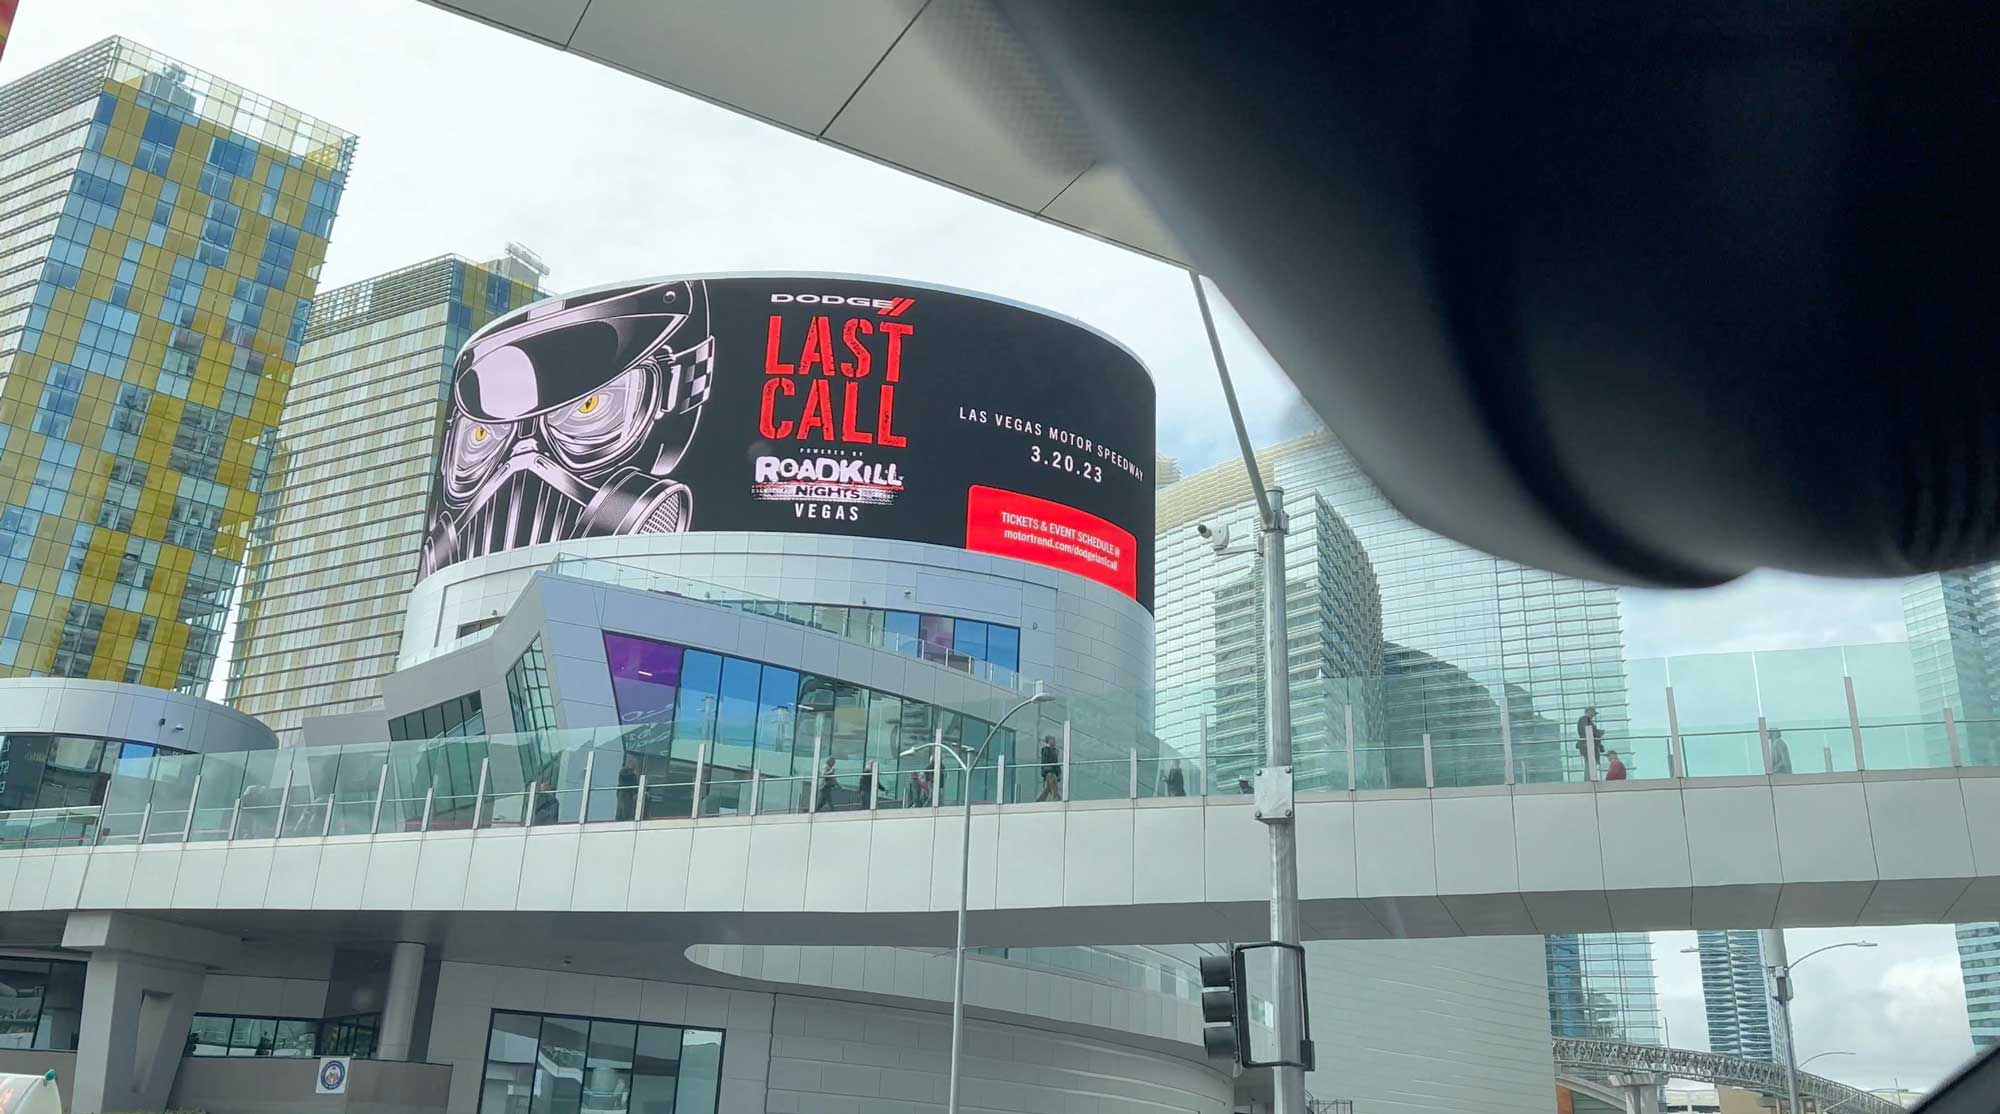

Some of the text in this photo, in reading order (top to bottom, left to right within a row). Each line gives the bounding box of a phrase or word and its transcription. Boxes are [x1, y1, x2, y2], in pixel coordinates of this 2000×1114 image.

[770, 294, 895, 309] DODGE
[764, 315, 914, 383] LAST
[759, 377, 907, 448] CALL
[959, 406, 1144, 482] LAS VEGAS MOTOR SPEEDWAY
[1030, 445, 1103, 483] 3.20.23
[794, 502, 860, 521] VEGAS
[1001, 511, 1040, 530] TICKETS
[1040, 520, 1048, 532] &
[1049, 523, 1077, 540] EVENT
[1077, 531, 1115, 556] SCHEDULE
